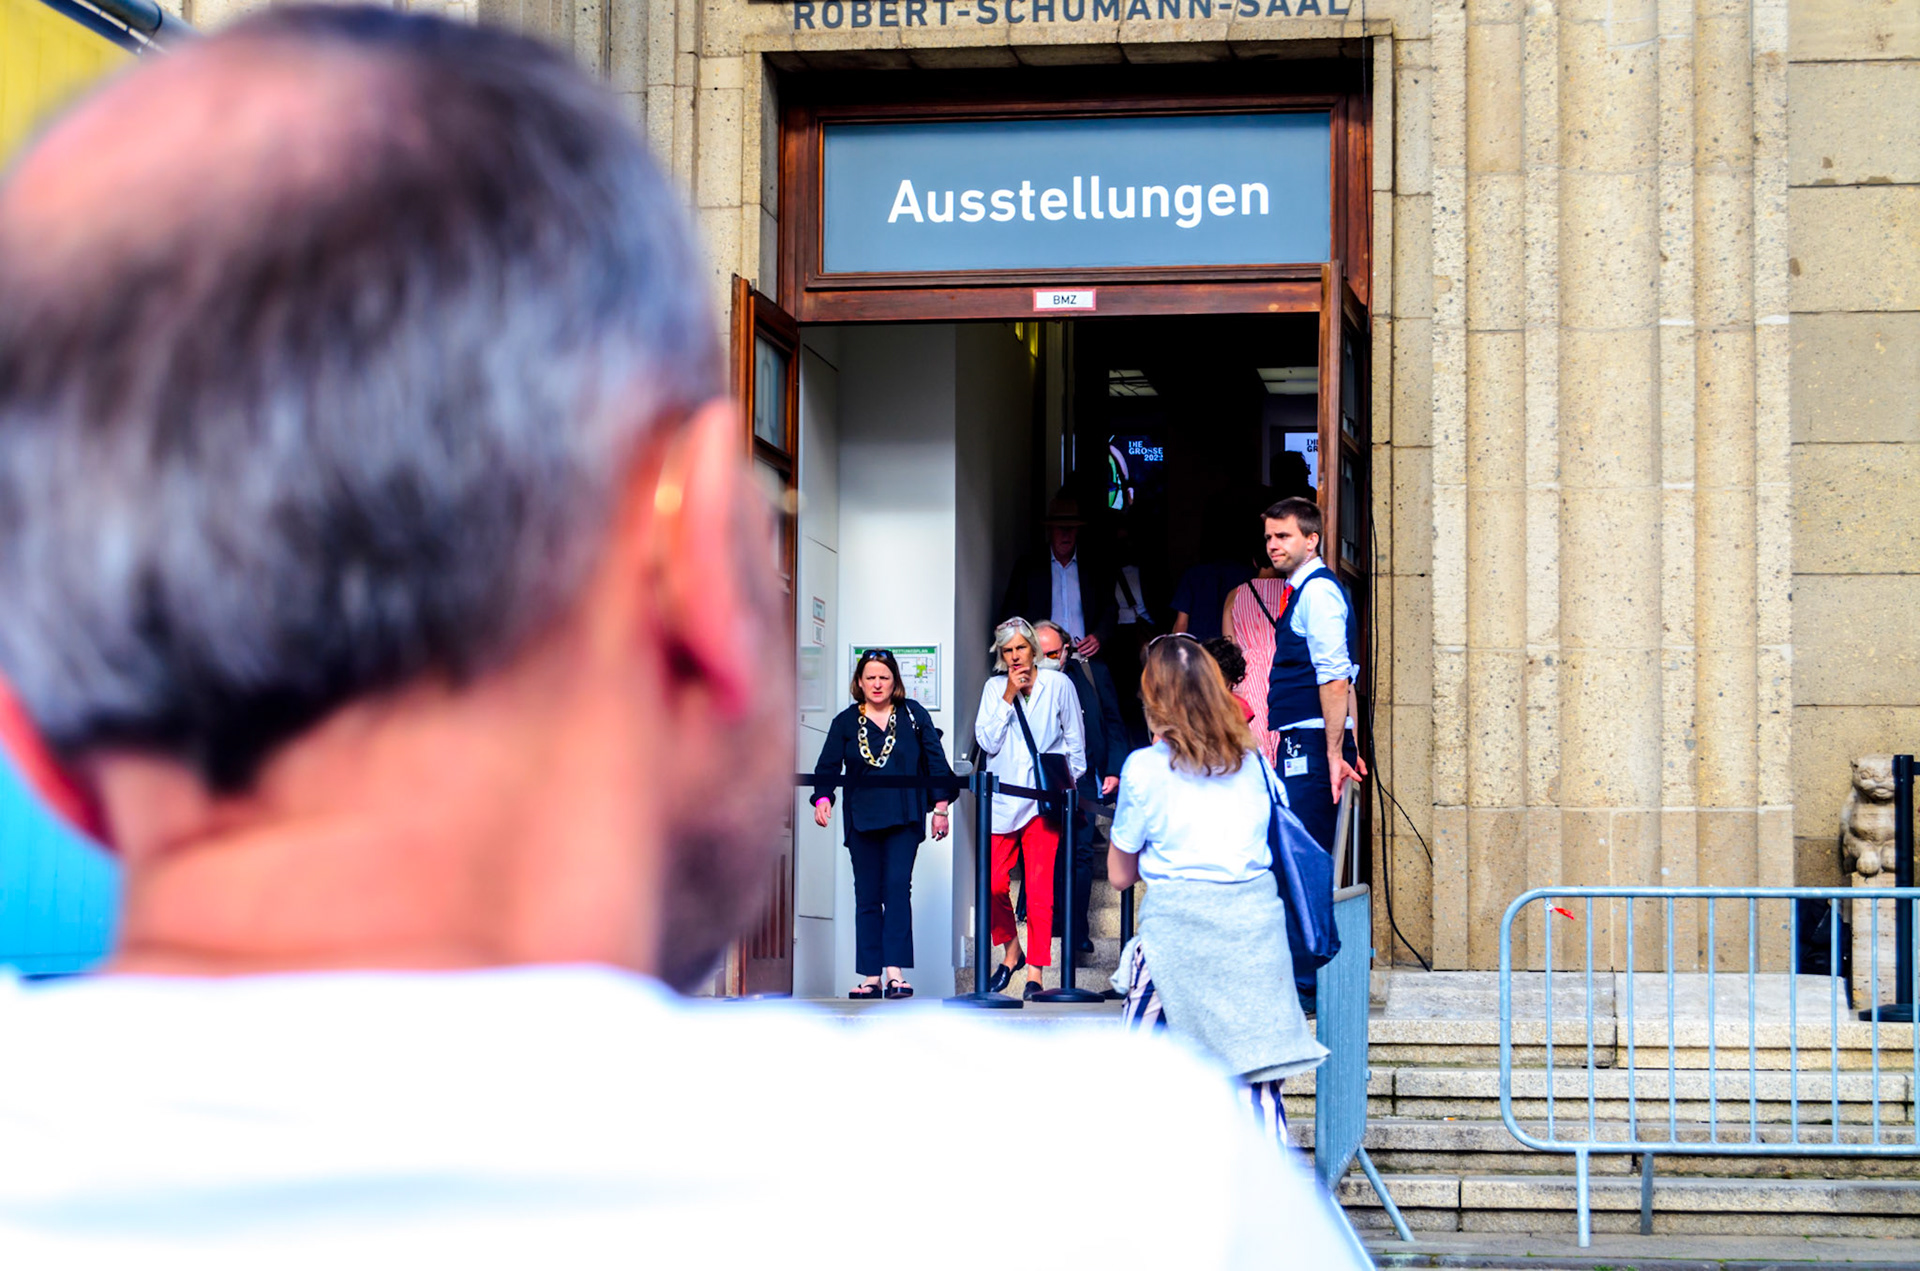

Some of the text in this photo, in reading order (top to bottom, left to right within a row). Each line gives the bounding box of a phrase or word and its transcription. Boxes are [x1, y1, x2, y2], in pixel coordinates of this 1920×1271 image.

[794, 0, 1350, 30] ROBERT-SCHUMANN-SAAL
[888, 176, 1269, 229] Ausstellungen
[1053, 295, 1077, 305] BMZ
[1129, 440, 1143, 448] DIE
[1129, 447, 1164, 455] GROSSE
